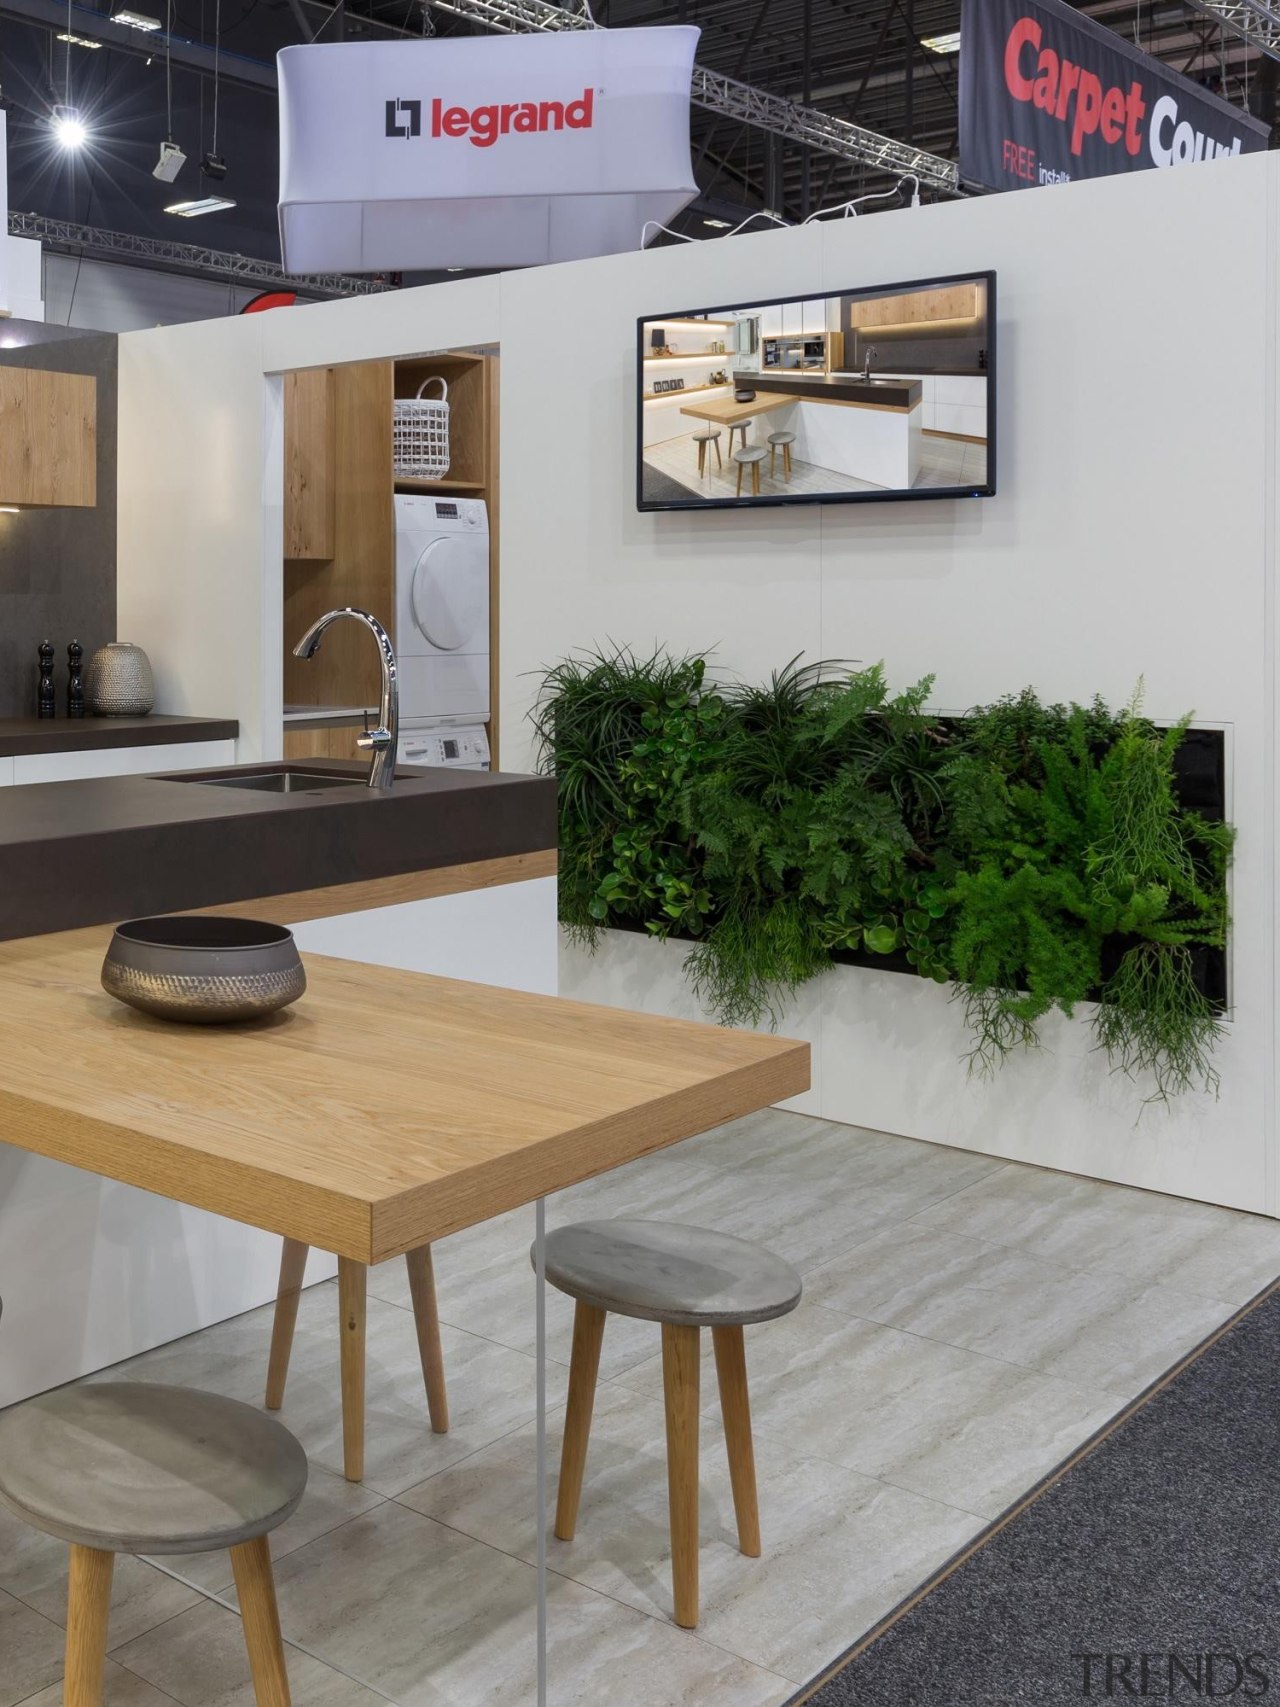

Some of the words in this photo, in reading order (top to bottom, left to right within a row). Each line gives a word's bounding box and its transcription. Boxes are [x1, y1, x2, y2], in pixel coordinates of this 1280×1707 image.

[431, 88, 594, 148] legrand
[1004, 16, 1146, 157] Carpet
[1149, 95, 1242, 168] Cou
[1002, 139, 1036, 181] FREE
